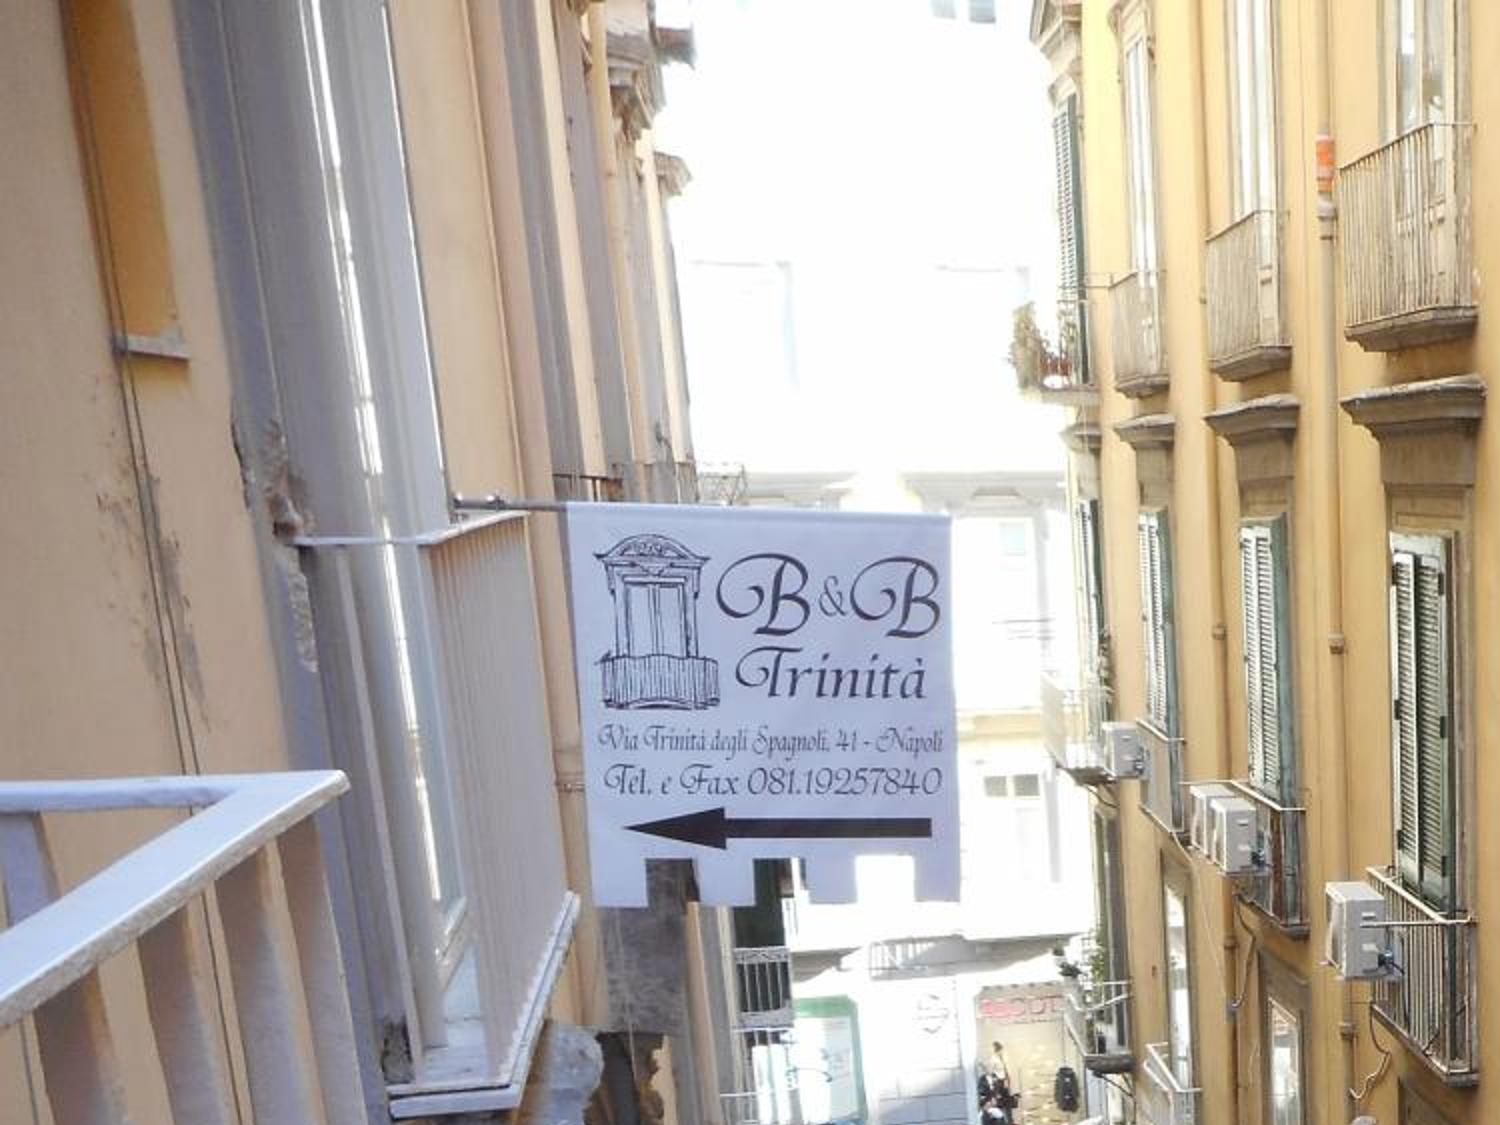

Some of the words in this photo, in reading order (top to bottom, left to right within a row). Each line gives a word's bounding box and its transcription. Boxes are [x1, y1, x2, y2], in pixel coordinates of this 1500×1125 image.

[716, 553, 941, 638] B&B
[736, 646, 928, 698] Trinità
[598, 724, 639, 751] Via
[710, 727, 749, 761] degli
[835, 728, 857, 752] 41
[876, 727, 944, 759] Napoli
[604, 763, 652, 795] Tel.
[661, 776, 673, 795] e
[680, 763, 740, 795] Fax
[748, 766, 943, 795] 081.19257840
